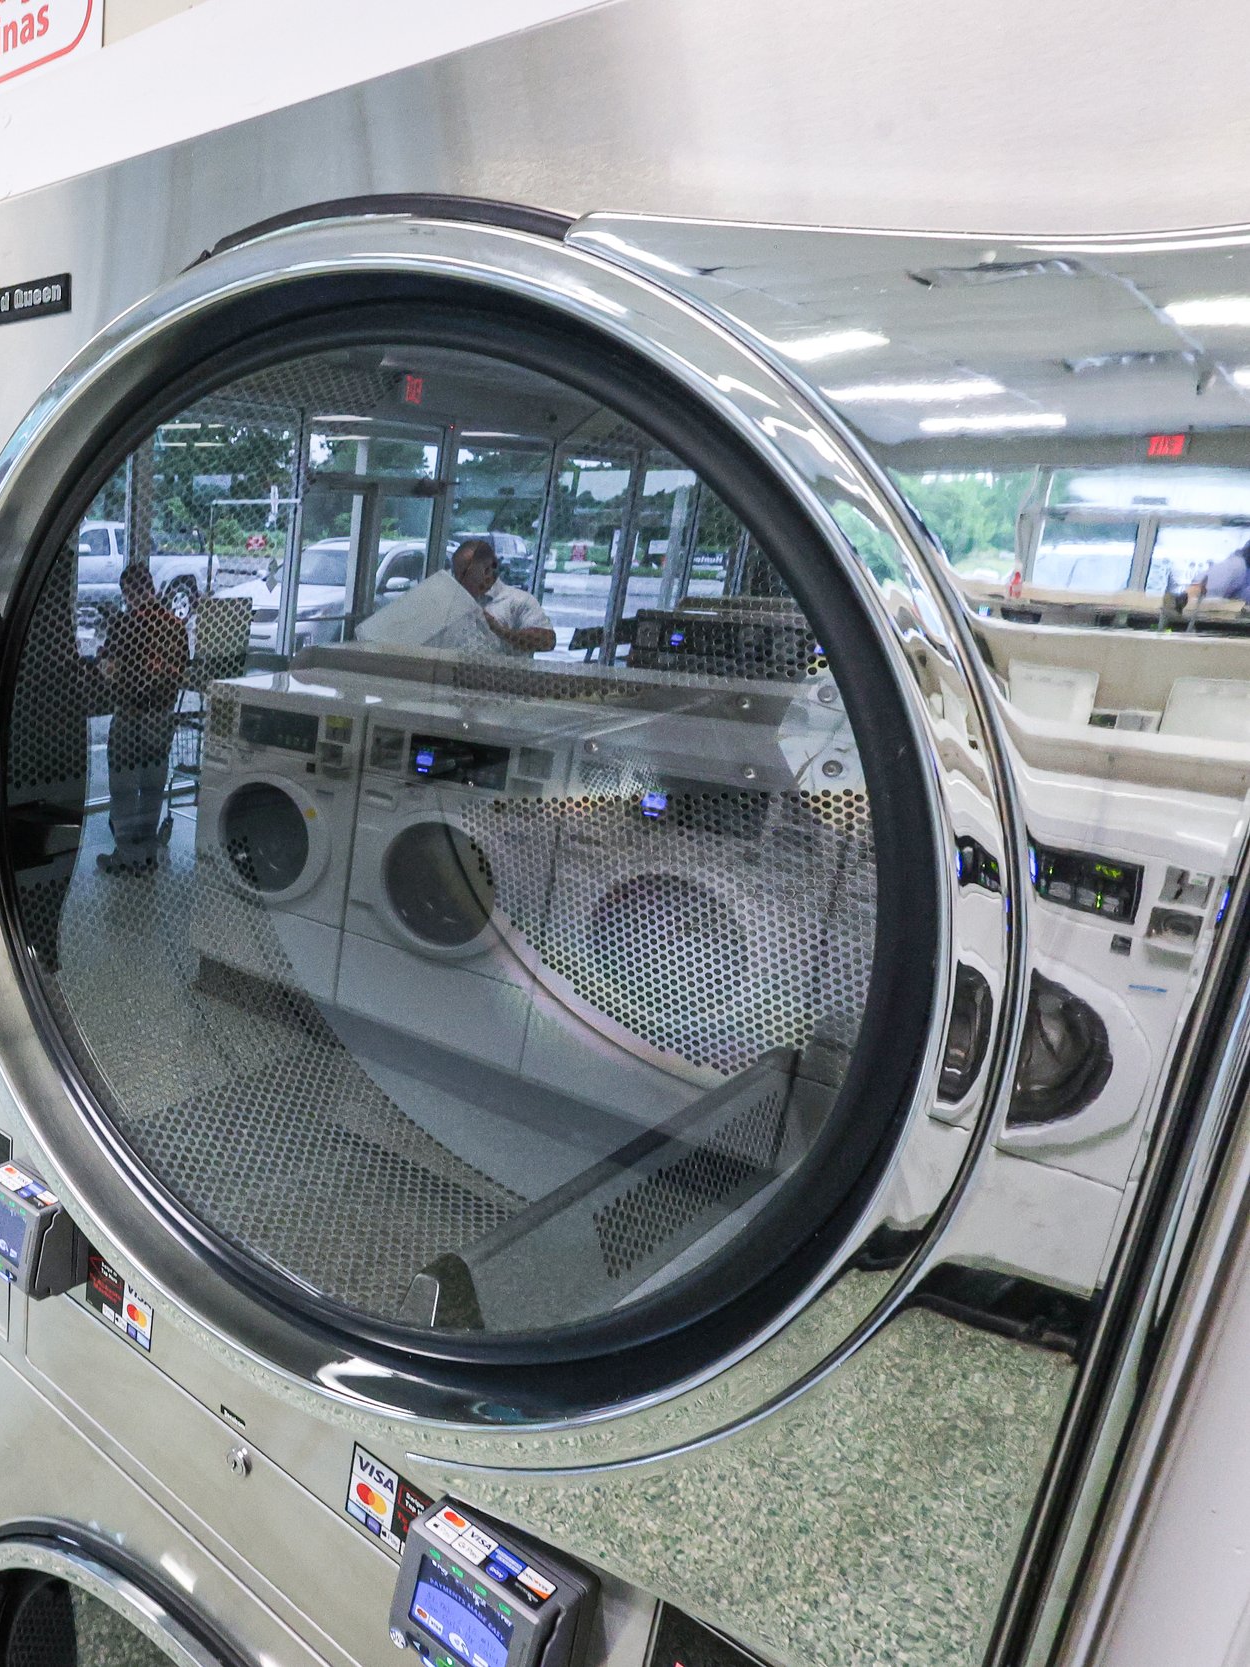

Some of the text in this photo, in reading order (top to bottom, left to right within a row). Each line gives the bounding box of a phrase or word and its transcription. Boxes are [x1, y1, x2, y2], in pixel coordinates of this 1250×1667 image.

[13, 284, 62, 309] Queen
[357, 1453, 395, 1495] VISA
[470, 1531, 492, 1550] VISA
[430, 1577, 466, 1606] PAYMENTS
[467, 1602, 488, 1623] MADE
[488, 1622, 505, 1641] EASY
